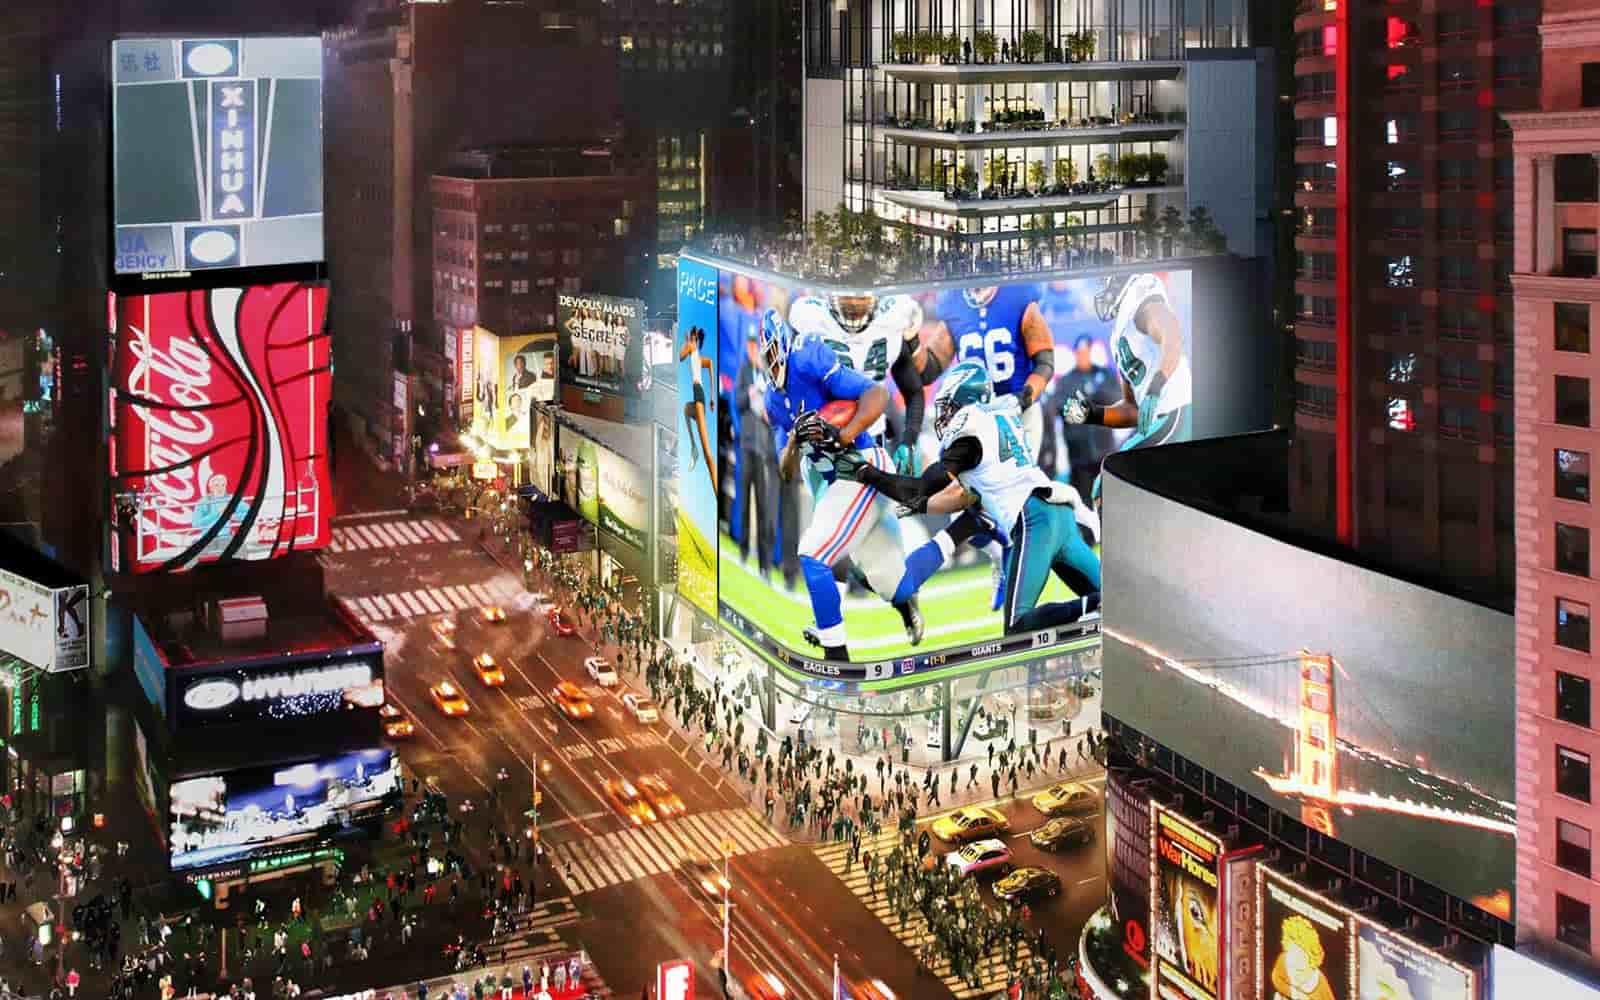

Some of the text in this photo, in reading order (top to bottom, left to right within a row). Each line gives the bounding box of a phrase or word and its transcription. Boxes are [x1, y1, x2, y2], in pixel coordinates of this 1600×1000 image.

[220, 87, 244, 213] XINHUA
[680, 272, 715, 305] PACE
[560, 295, 636, 318] DEVIOUS MAIDS
[959, 327, 1015, 382] 66
[971, 632, 1049, 657] GIANTS 10
[803, 661, 840, 676] EAGLES
[874, 664, 882, 677] 9
[1159, 838, 1181, 866] War
